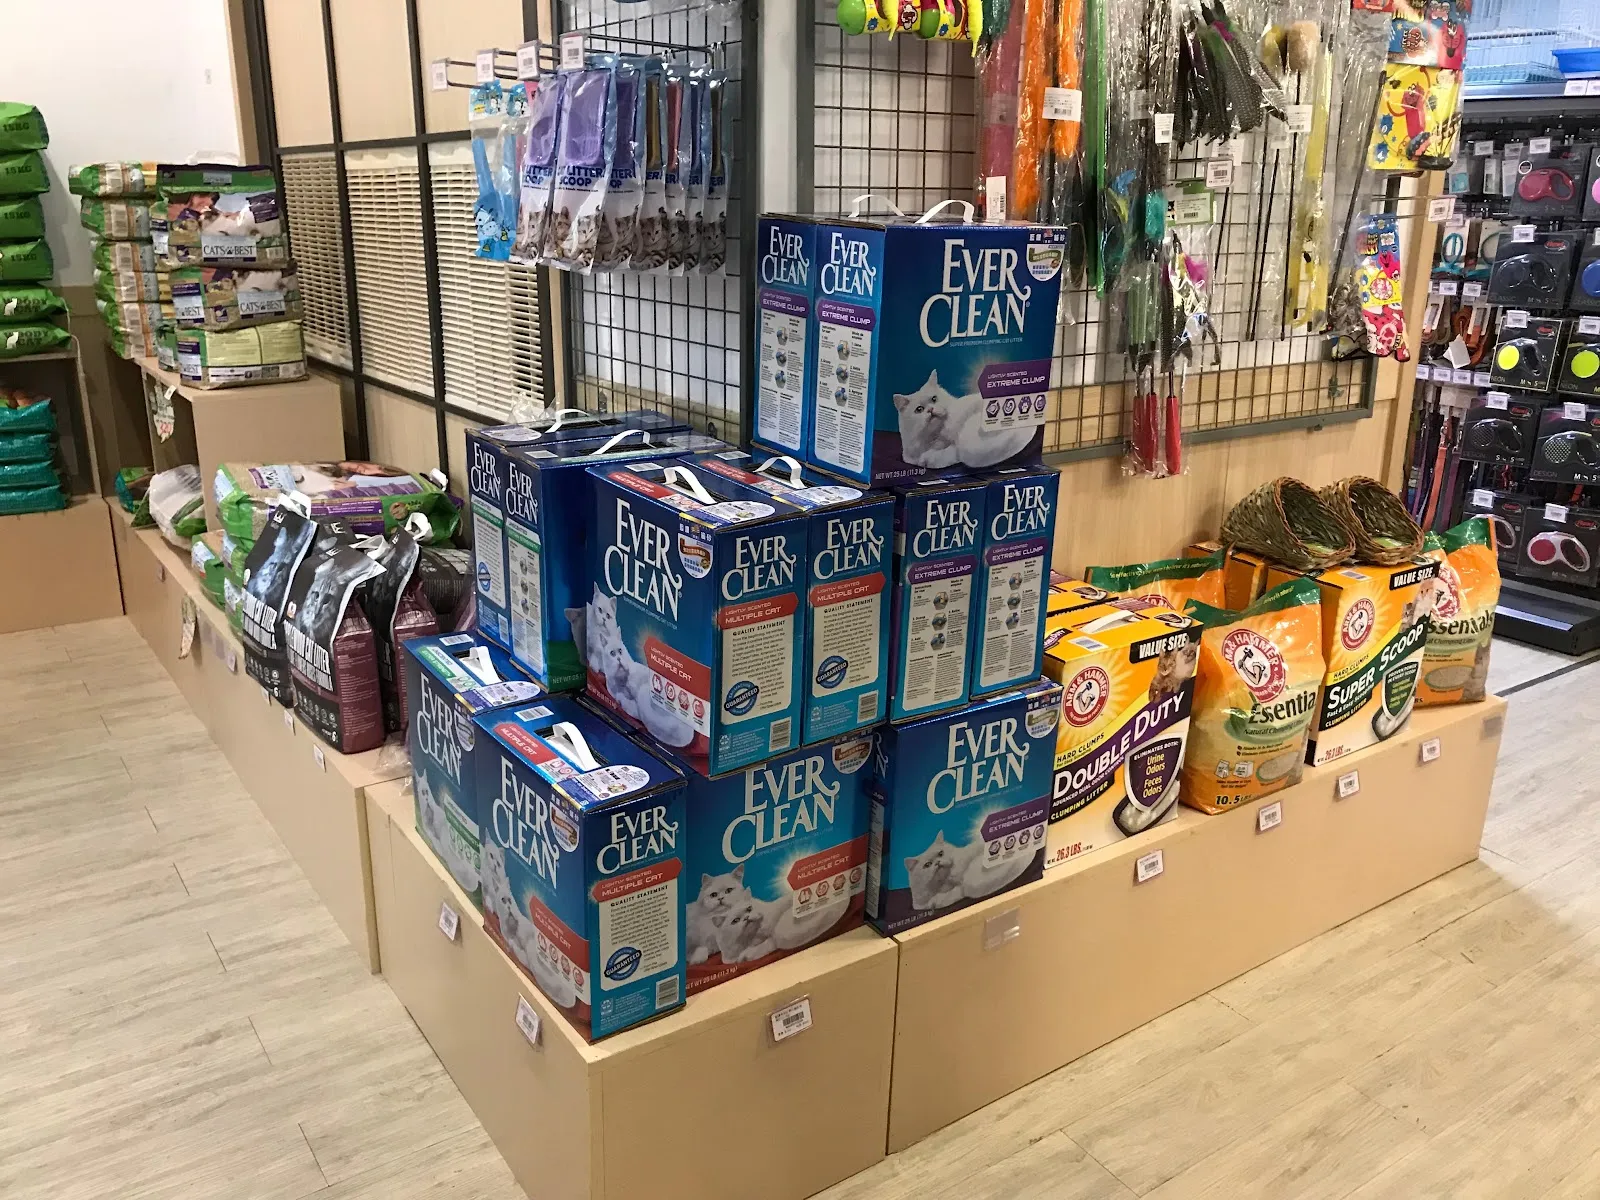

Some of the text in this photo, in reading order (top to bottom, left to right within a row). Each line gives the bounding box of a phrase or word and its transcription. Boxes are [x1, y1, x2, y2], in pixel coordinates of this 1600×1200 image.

[567, 166, 602, 177] LITTER
[234, 245, 253, 255] BEST
[770, 226, 809, 264] EVER
[831, 232, 876, 275] EVER
[762, 254, 808, 286] CLEAN
[821, 263, 874, 297] CLEAN
[942, 239, 1031, 300] EVER
[822, 310, 871, 325] EXTREME CLUMP
[919, 293, 1026, 348] CLEAN
[987, 376, 1046, 388] EXTREME CLUMP
[474, 442, 500, 481] EVER
[1533, 470, 1558, 478] DESIGN
[471, 466, 500, 501] CLEAN
[509, 462, 538, 507] EVER
[1003, 484, 1050, 513] EVER
[506, 487, 538, 525] CLEAN
[926, 499, 978, 529] EVER
[827, 518, 884, 549] EVER
[991, 507, 1047, 541] CLEAN
[617, 498, 682, 588] EVER
[736, 535, 797, 568] EVER
[913, 524, 975, 558] CLEAN
[992, 545, 1044, 561] EXTREME CLUMP
[813, 541, 881, 580] CLEAN
[914, 564, 972, 580] EXTREME CLUMP
[605, 545, 678, 621] CLEAN
[721, 560, 794, 601] CLEAN
[817, 585, 870, 602] MULTIPLE CAT
[1393, 567, 1433, 589] VALUE SIZE
[725, 606, 782, 624] MULTIPLE CAT
[748, 602, 771, 611] SCENTED
[1343, 616, 1354, 633] ARM
[1357, 600, 1373, 625] HAMMER
[1139, 633, 1188, 660] VALUE SIZE
[651, 654, 692, 682] MULTIPLE CAT
[1327, 667, 1376, 709] SUPER
[1379, 623, 1424, 671] SCOOP
[1333, 654, 1369, 679] HARD CLUMPS
[725, 687, 758, 709] GUARANTEED
[1066, 683, 1078, 707] ARM
[1084, 668, 1107, 697] HAMMER
[421, 672, 461, 758] EVER
[1248, 690, 1317, 724] Essentia
[1325, 698, 1367, 728] CLUMPING LITTER
[1326, 709, 1339, 719] Fast
[417, 710, 461, 785] CLEAN
[947, 717, 1030, 768] EVER
[1053, 690, 1185, 800] DOUBLE DUTY
[1057, 732, 1105, 763] HARD CLUMPS
[1244, 727, 1267, 736] Natural
[1134, 745, 1163, 760] ELIMINATES
[1145, 762, 1166, 775] Odors
[1147, 753, 1165, 766] Urine
[745, 755, 840, 815] EVER
[926, 752, 1025, 814] CLEAN
[1052, 775, 1105, 808] ADVANCED DUAL ODOR
[1142, 786, 1162, 799] Odors
[1144, 776, 1162, 789] Feces
[501, 755, 560, 858] EVER
[1051, 781, 1109, 820] CLUMPING LITTER
[1216, 795, 1241, 805] 10.5
[611, 806, 678, 844] EVER
[722, 792, 836, 864] CLEAN
[989, 809, 1044, 833] EXTREME CLUMP
[493, 798, 557, 889] CLEAN
[597, 830, 676, 874] CLEAN
[1056, 844, 1070, 862] 26.3
[797, 855, 850, 880] MULTIPLE CAT
[602, 872, 663, 897] MULTIPLE CAT
[606, 952, 641, 975] GUARANTEED
